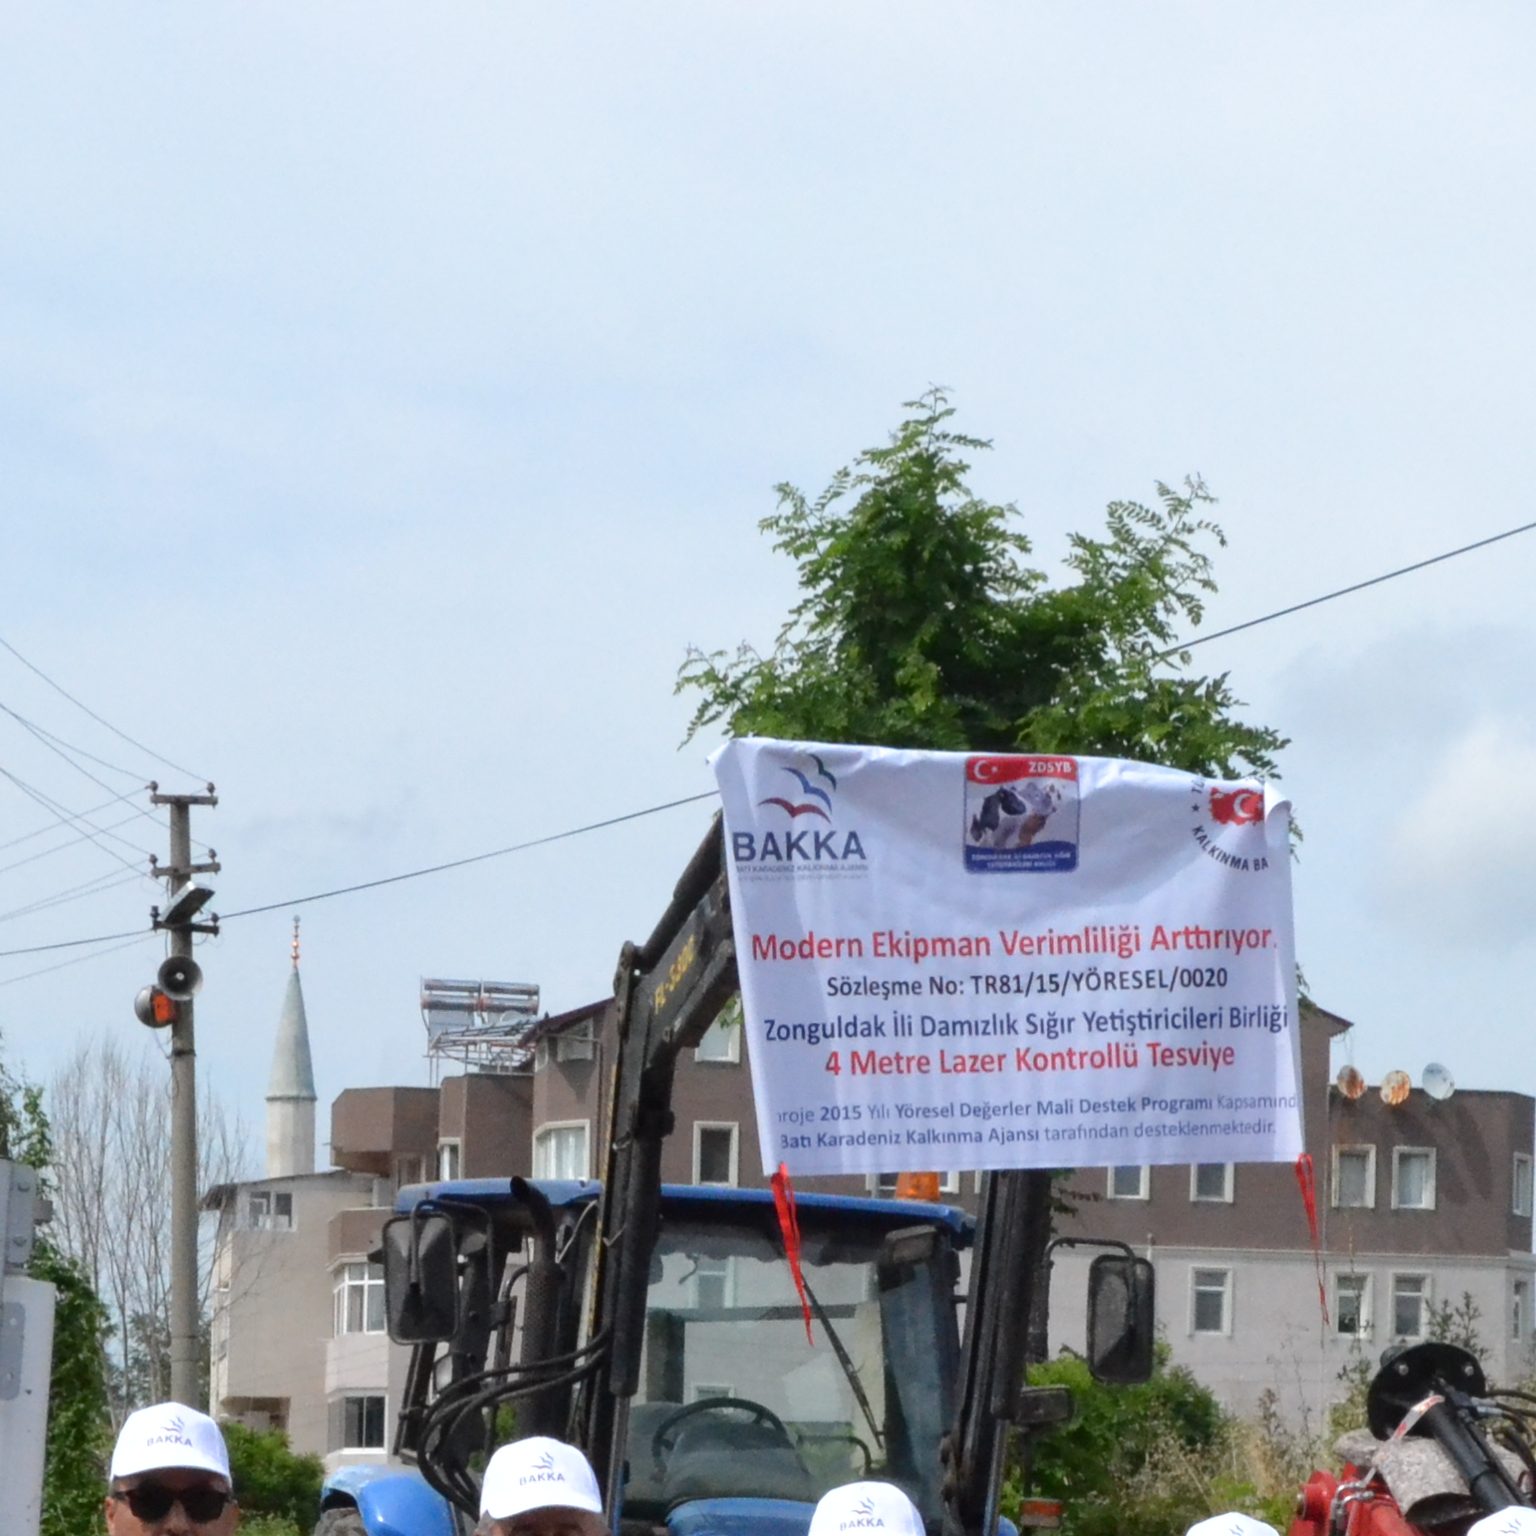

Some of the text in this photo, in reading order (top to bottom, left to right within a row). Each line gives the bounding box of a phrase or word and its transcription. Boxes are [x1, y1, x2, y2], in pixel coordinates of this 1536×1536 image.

[1029, 761, 1072, 773] ZDSYB
[732, 830, 867, 861] BAKKA
[1192, 825, 1249, 871] KALKINMA
[752, 931, 863, 960] Modern
[872, 930, 991, 964] Ekipman
[999, 925, 1141, 959] Verimliliği
[827, 966, 1228, 1000] Sözleşme No: TR81/15/YÖRESEL/0020
[764, 1005, 1287, 1044] Zonguldak İli Damızlık Sığır Yetiştiricileri Birliği
[825, 1040, 1235, 1075] 4 Metre Lazer Kontrollü Tesviye
[820, 1105, 862, 1121] 2015
[867, 1104, 890, 1120] Yılı
[894, 1102, 954, 1119] Yöresel
[960, 1101, 1031, 1120] Değerler
[1037, 1098, 1073, 1115] Mali
[1079, 1097, 1136, 1114] Destek
[1141, 1096, 1212, 1116] Programı
[781, 1118, 1276, 1149] Batı Karadeniz Kalkınma Ajansı tarafından desteklenmektedir.
[147, 1434, 193, 1447] BAKKA
[519, 1472, 565, 1486] BAKKA
[840, 1517, 885, 1531] BAKKA
